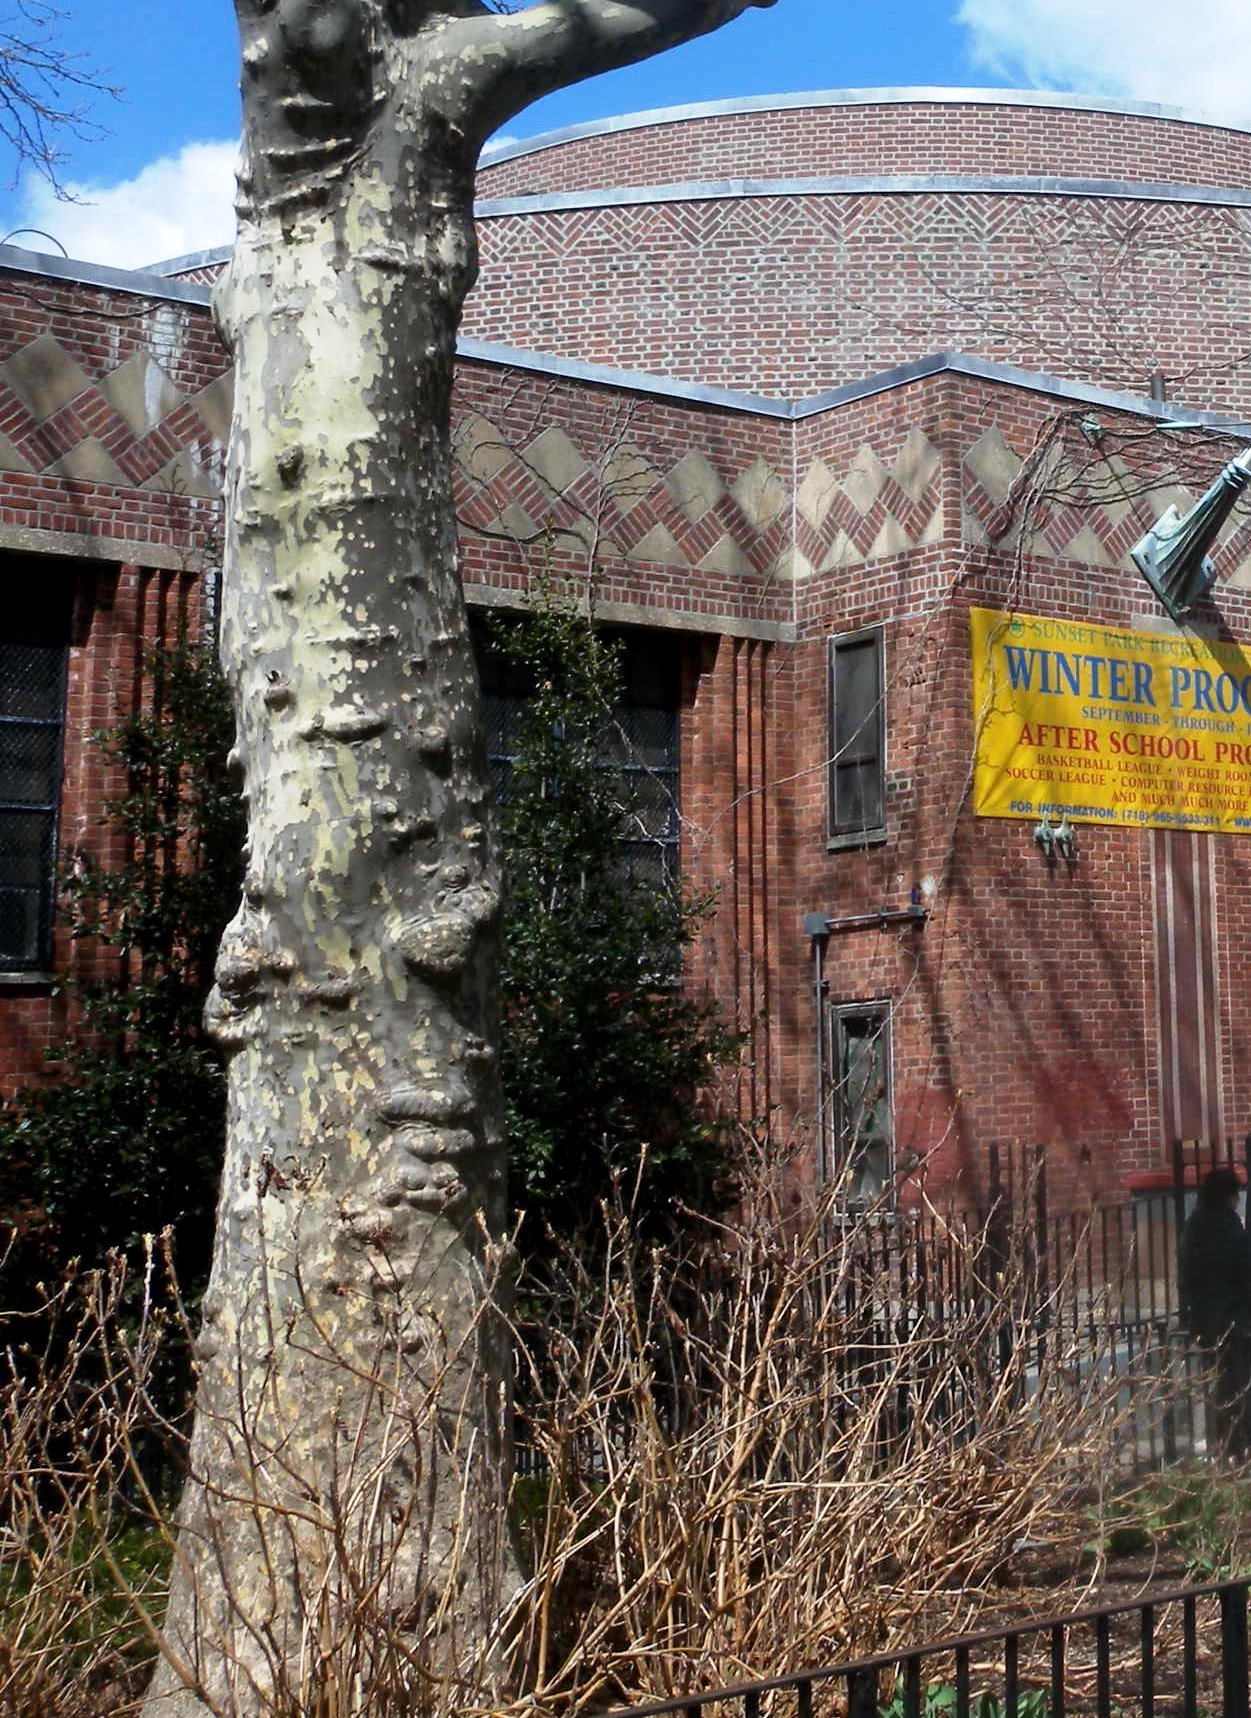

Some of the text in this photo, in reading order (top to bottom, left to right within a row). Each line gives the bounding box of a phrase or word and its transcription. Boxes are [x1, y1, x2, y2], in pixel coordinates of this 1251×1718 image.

[1032, 621, 1097, 645] SUNSET
[1103, 632, 1144, 650] PARK
[1003, 645, 1157, 707] WINTER
[1081, 705, 1160, 726] SEPTEMBER
[1173, 715, 1234, 733] THROUGH
[1018, 722, 1100, 752] AFTER
[1110, 731, 1205, 761] SCHOOL
[1038, 754, 1113, 770] BASKETBALL
[1118, 761, 1161, 775] LEAGUE
[1177, 766, 1220, 780] WEIGHT
[1007, 766, 1057, 781] SOCCER
[1059, 772, 1106, 786] LEAGUE
[1121, 776, 1184, 791] COMPUTER
[1188, 783, 1245, 797] RESOURCE
[1009, 800, 1033, 814] FOR
[1112, 791, 1249, 811] AND MUCH MUCH MORE
